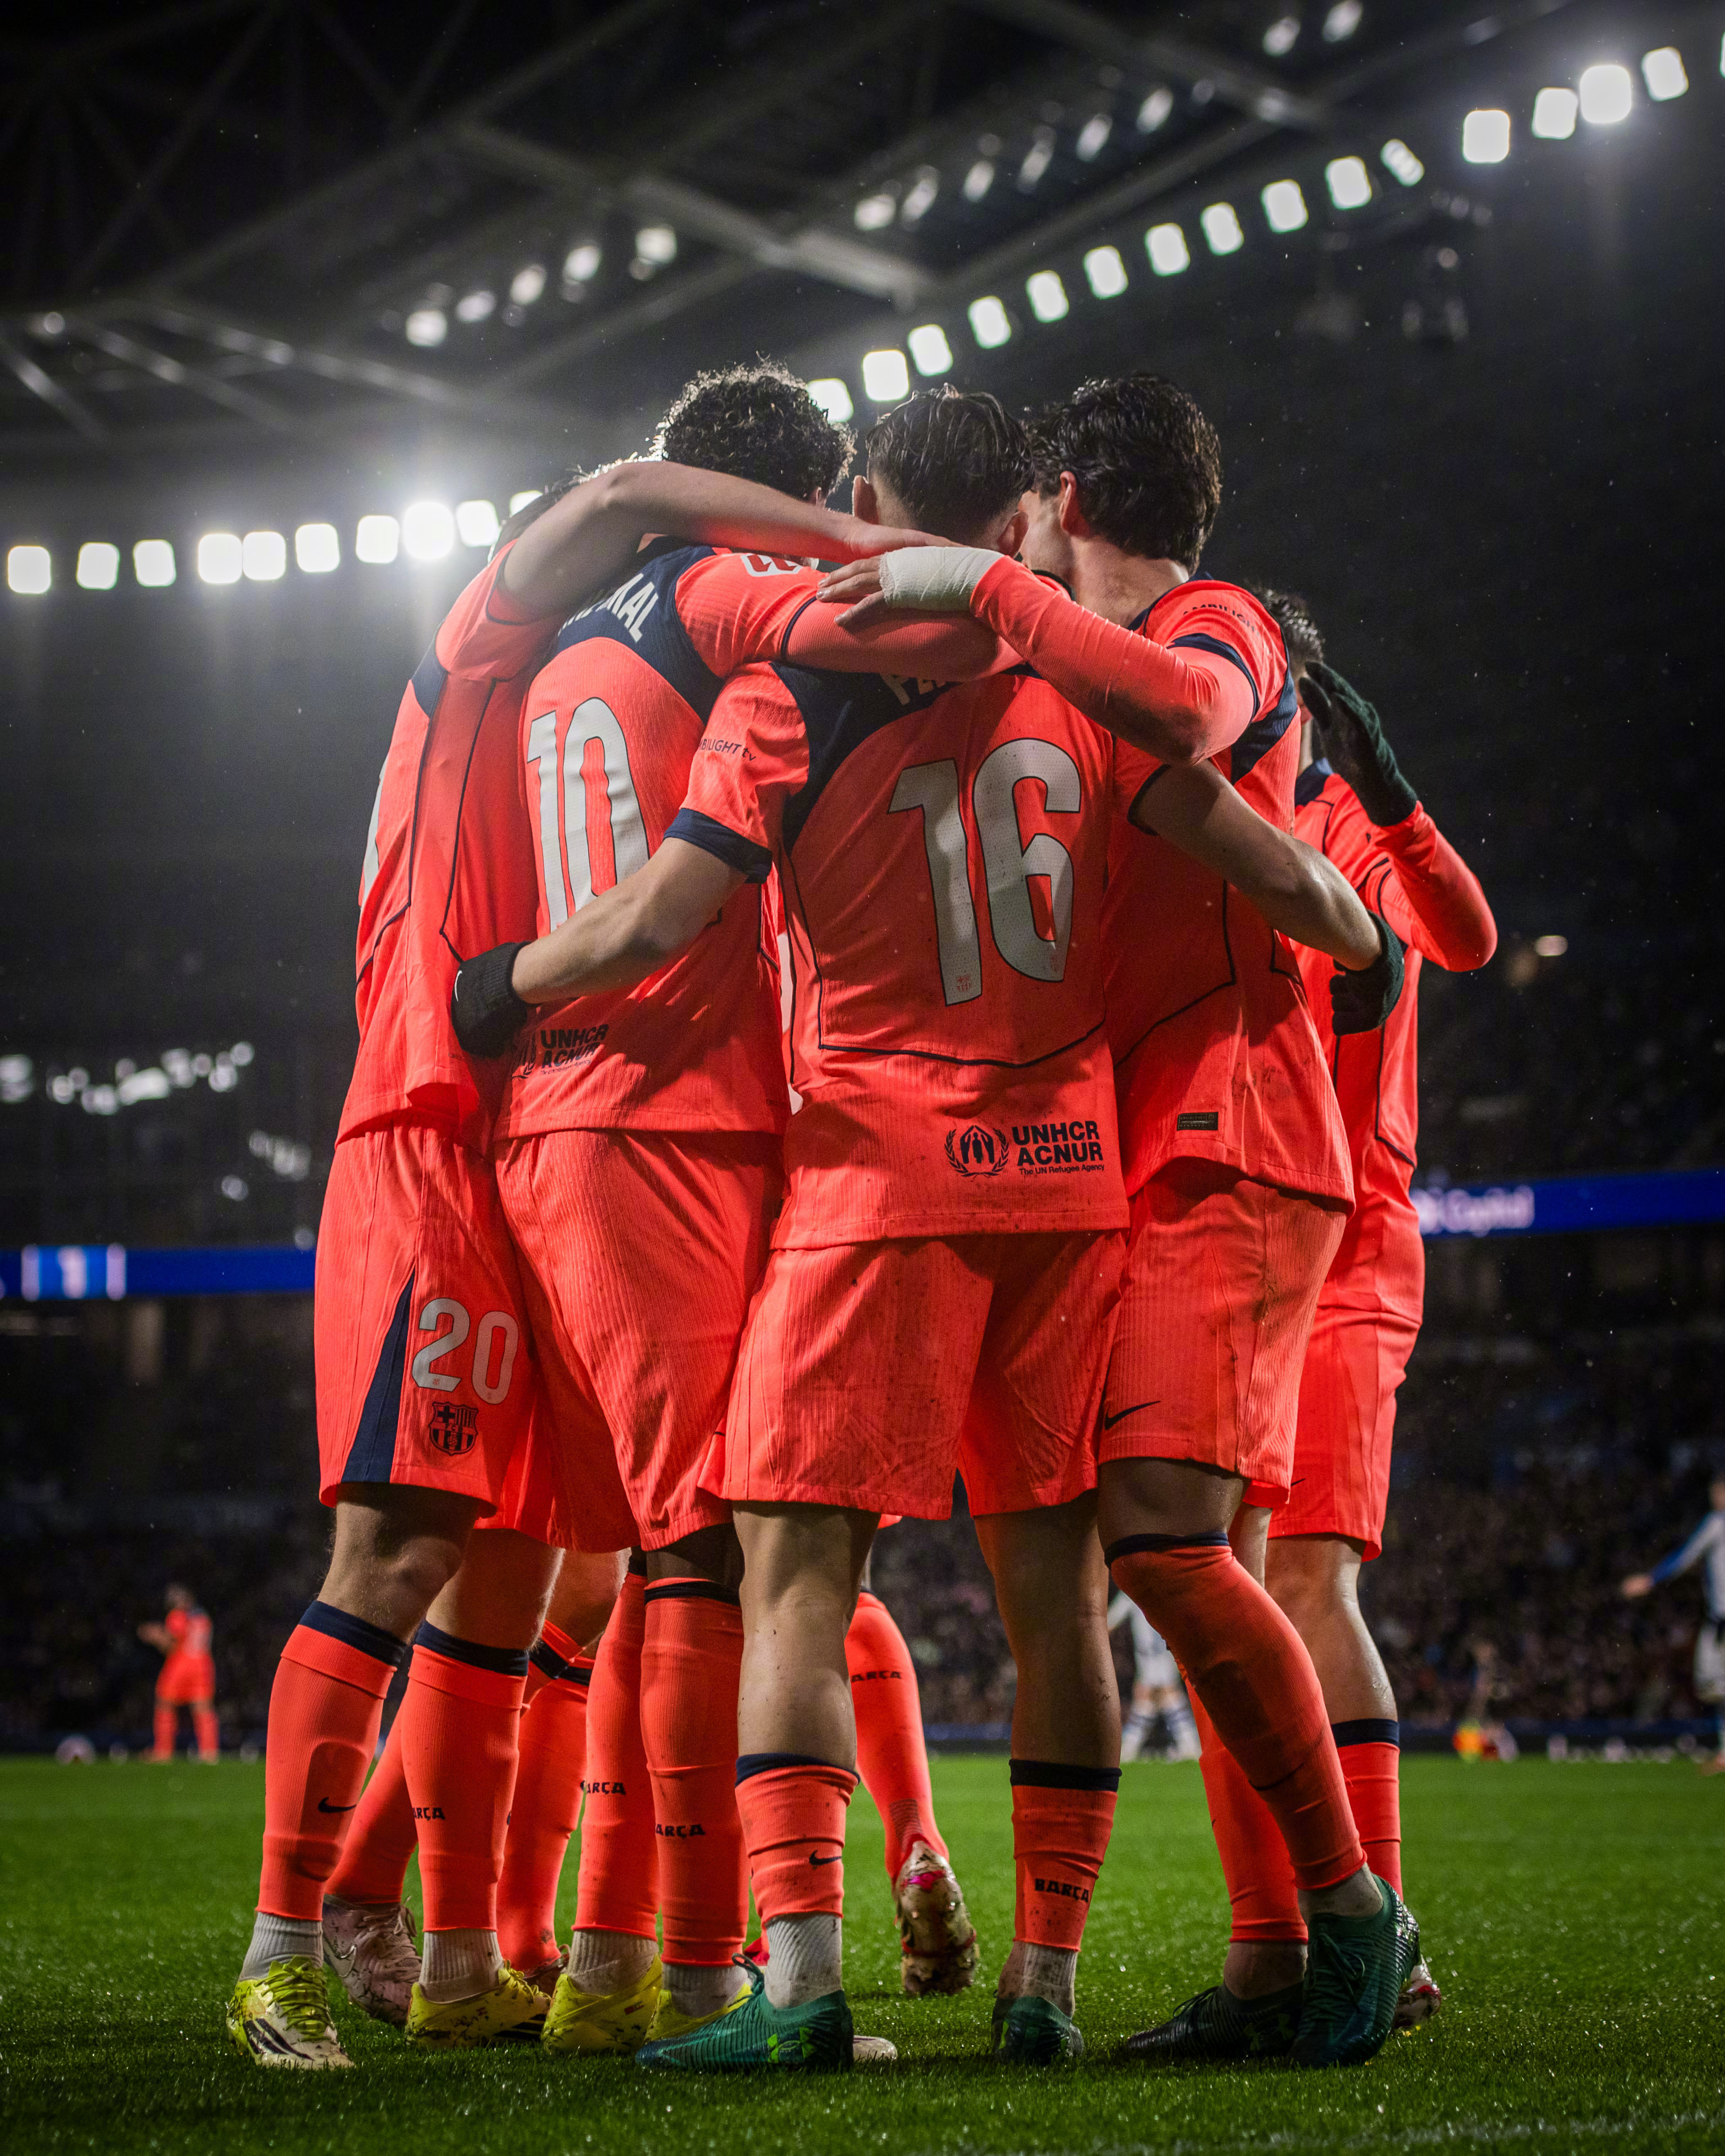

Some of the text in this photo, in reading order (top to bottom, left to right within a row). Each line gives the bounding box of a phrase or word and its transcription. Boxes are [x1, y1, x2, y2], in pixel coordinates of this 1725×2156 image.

[742, 748, 756, 761] tv
[527, 697, 650, 933] 10
[887, 737, 1081, 1007] 16
[540, 1024, 609, 1049] UNHCR
[542, 1042, 600, 1068] ACNUR
[1011, 1120, 1100, 1145] UNHCR
[1017, 1142, 1103, 1166] ACNUR
[411, 1298, 519, 1405] 20
[851, 1671, 902, 1683] ARÇA
[587, 1782, 626, 1795] ARÇA
[412, 1807, 445, 1821] ARÇA
[656, 1824, 706, 1839] ARÇA
[1035, 1878, 1089, 1903] BARÇA
